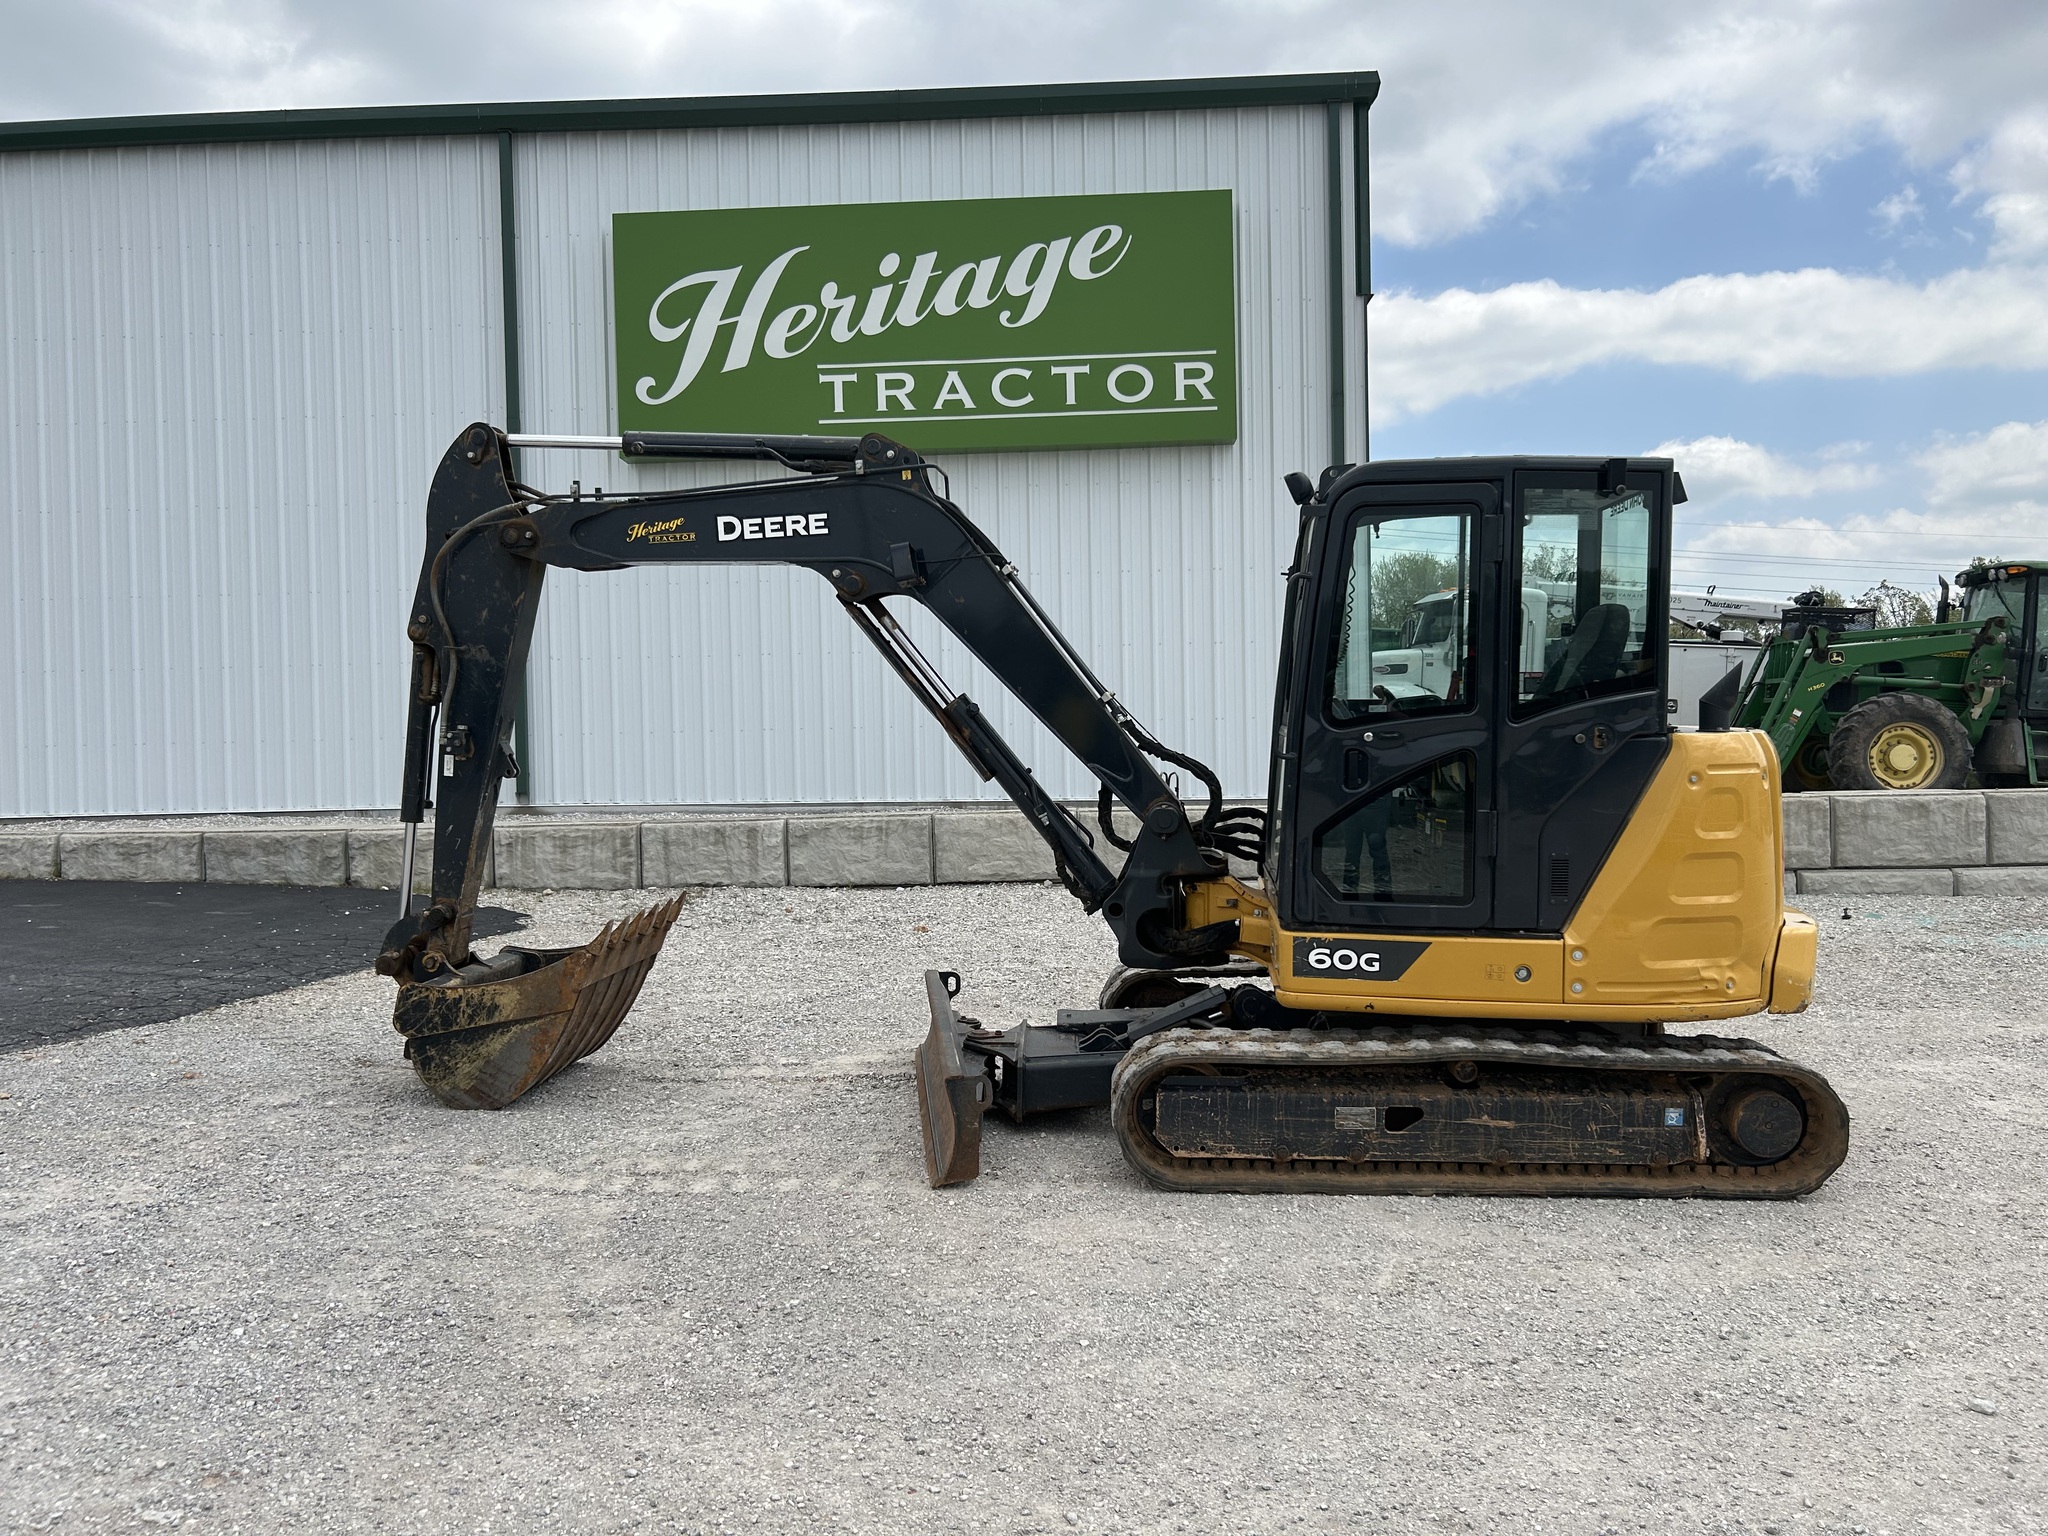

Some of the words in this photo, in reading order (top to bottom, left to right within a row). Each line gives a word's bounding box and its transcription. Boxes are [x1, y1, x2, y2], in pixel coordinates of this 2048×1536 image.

[634, 223, 1132, 406] Heritage
[818, 361, 1216, 414] TRACTOR
[626, 517, 686, 543] Heritage
[648, 532, 696, 543] TRACTOR
[716, 512, 829, 542] DEERE
[1807, 682, 1826, 692] H360
[1308, 947, 1381, 972] 60G
